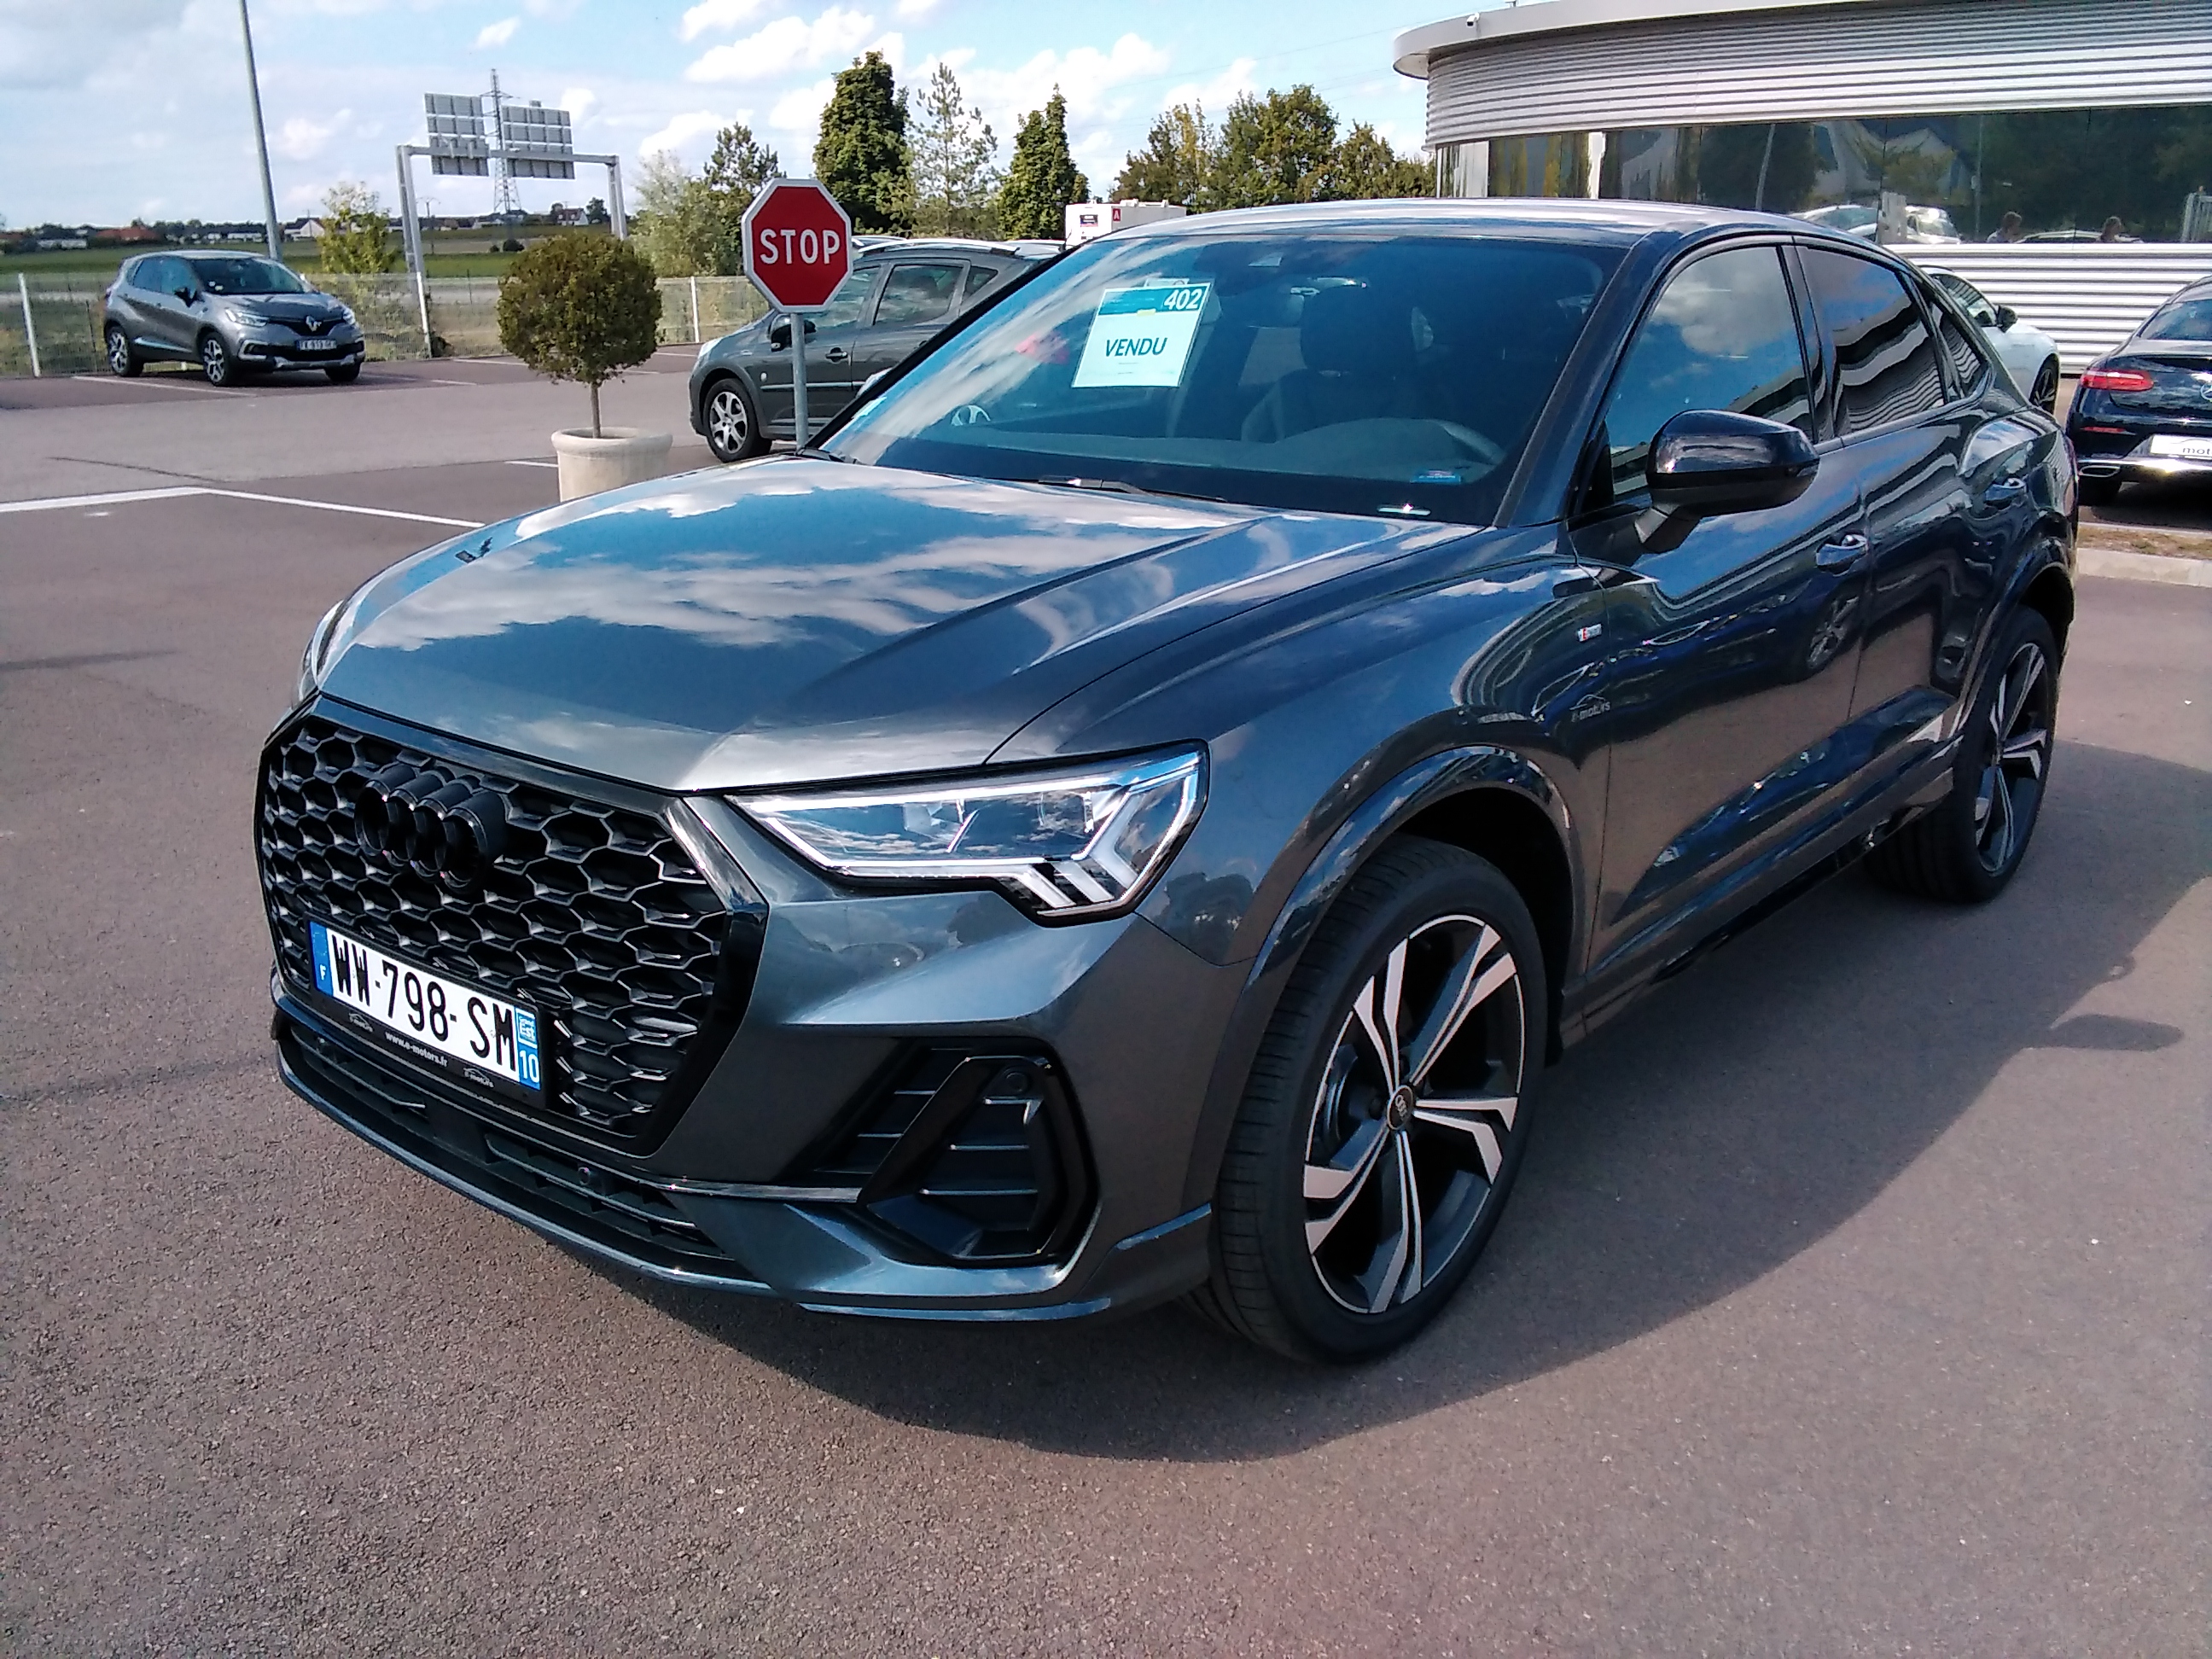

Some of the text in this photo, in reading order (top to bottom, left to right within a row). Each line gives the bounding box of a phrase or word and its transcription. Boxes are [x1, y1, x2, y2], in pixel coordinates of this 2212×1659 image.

[760, 229, 841, 265] STOP
[1163, 288, 1203, 310] 402
[1105, 337, 1168, 358] VENDU
[2182, 447, 2212, 456] mot
[319, 963, 327, 981] F
[384, 1031, 449, 1068] www.e-motors.fr
[519, 1050, 540, 1083] 10
